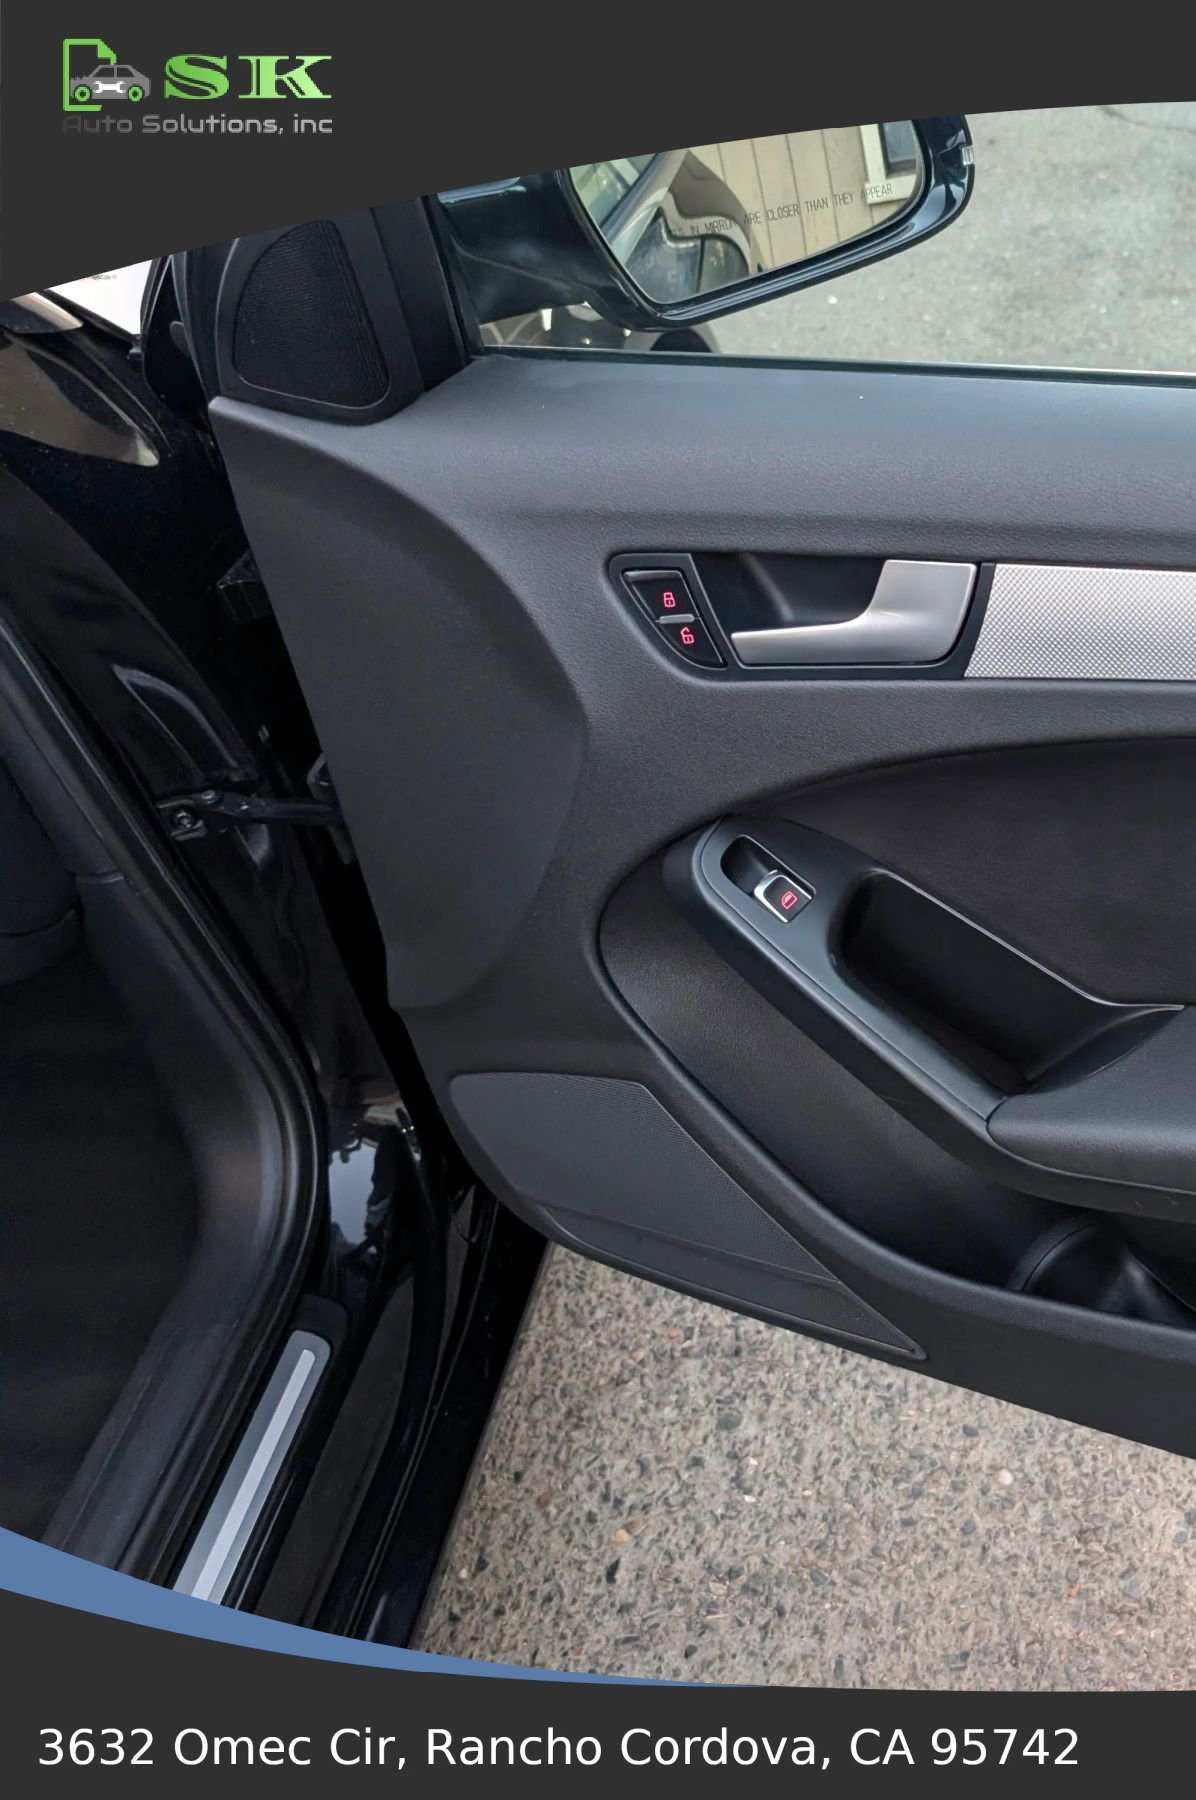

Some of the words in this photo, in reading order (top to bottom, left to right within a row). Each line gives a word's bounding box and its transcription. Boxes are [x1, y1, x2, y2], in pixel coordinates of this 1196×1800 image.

[743, 211, 761, 225] ARE
[766, 204, 800, 220] CLOSER
[805, 197, 829, 212] THAN
[833, 191, 855, 207] THEY
[860, 183, 893, 204] APPEAR
